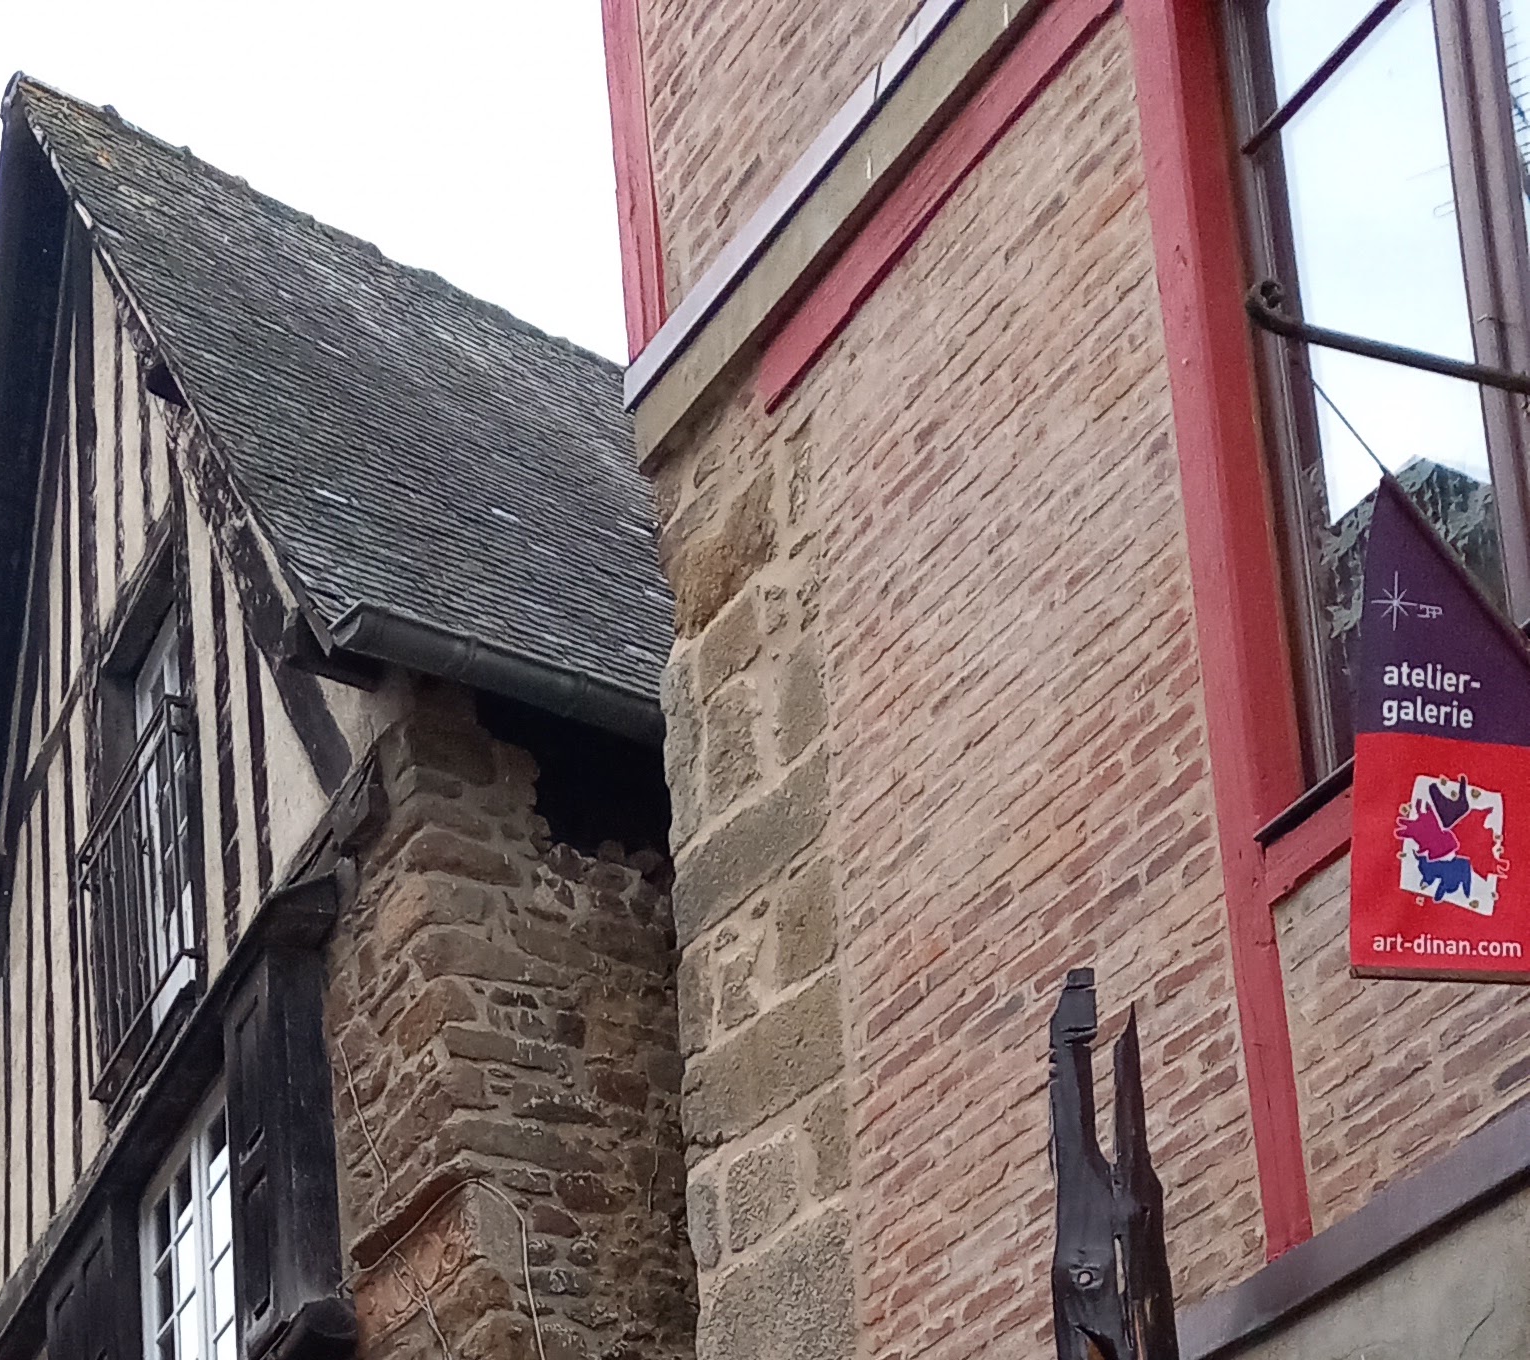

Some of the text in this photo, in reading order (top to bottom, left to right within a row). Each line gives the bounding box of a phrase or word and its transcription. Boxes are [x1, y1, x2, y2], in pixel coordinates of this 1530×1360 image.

[1382, 662, 1482, 694] atelier-
[1382, 700, 1475, 729] galerie
[1372, 932, 1523, 958] art-dinan.com
